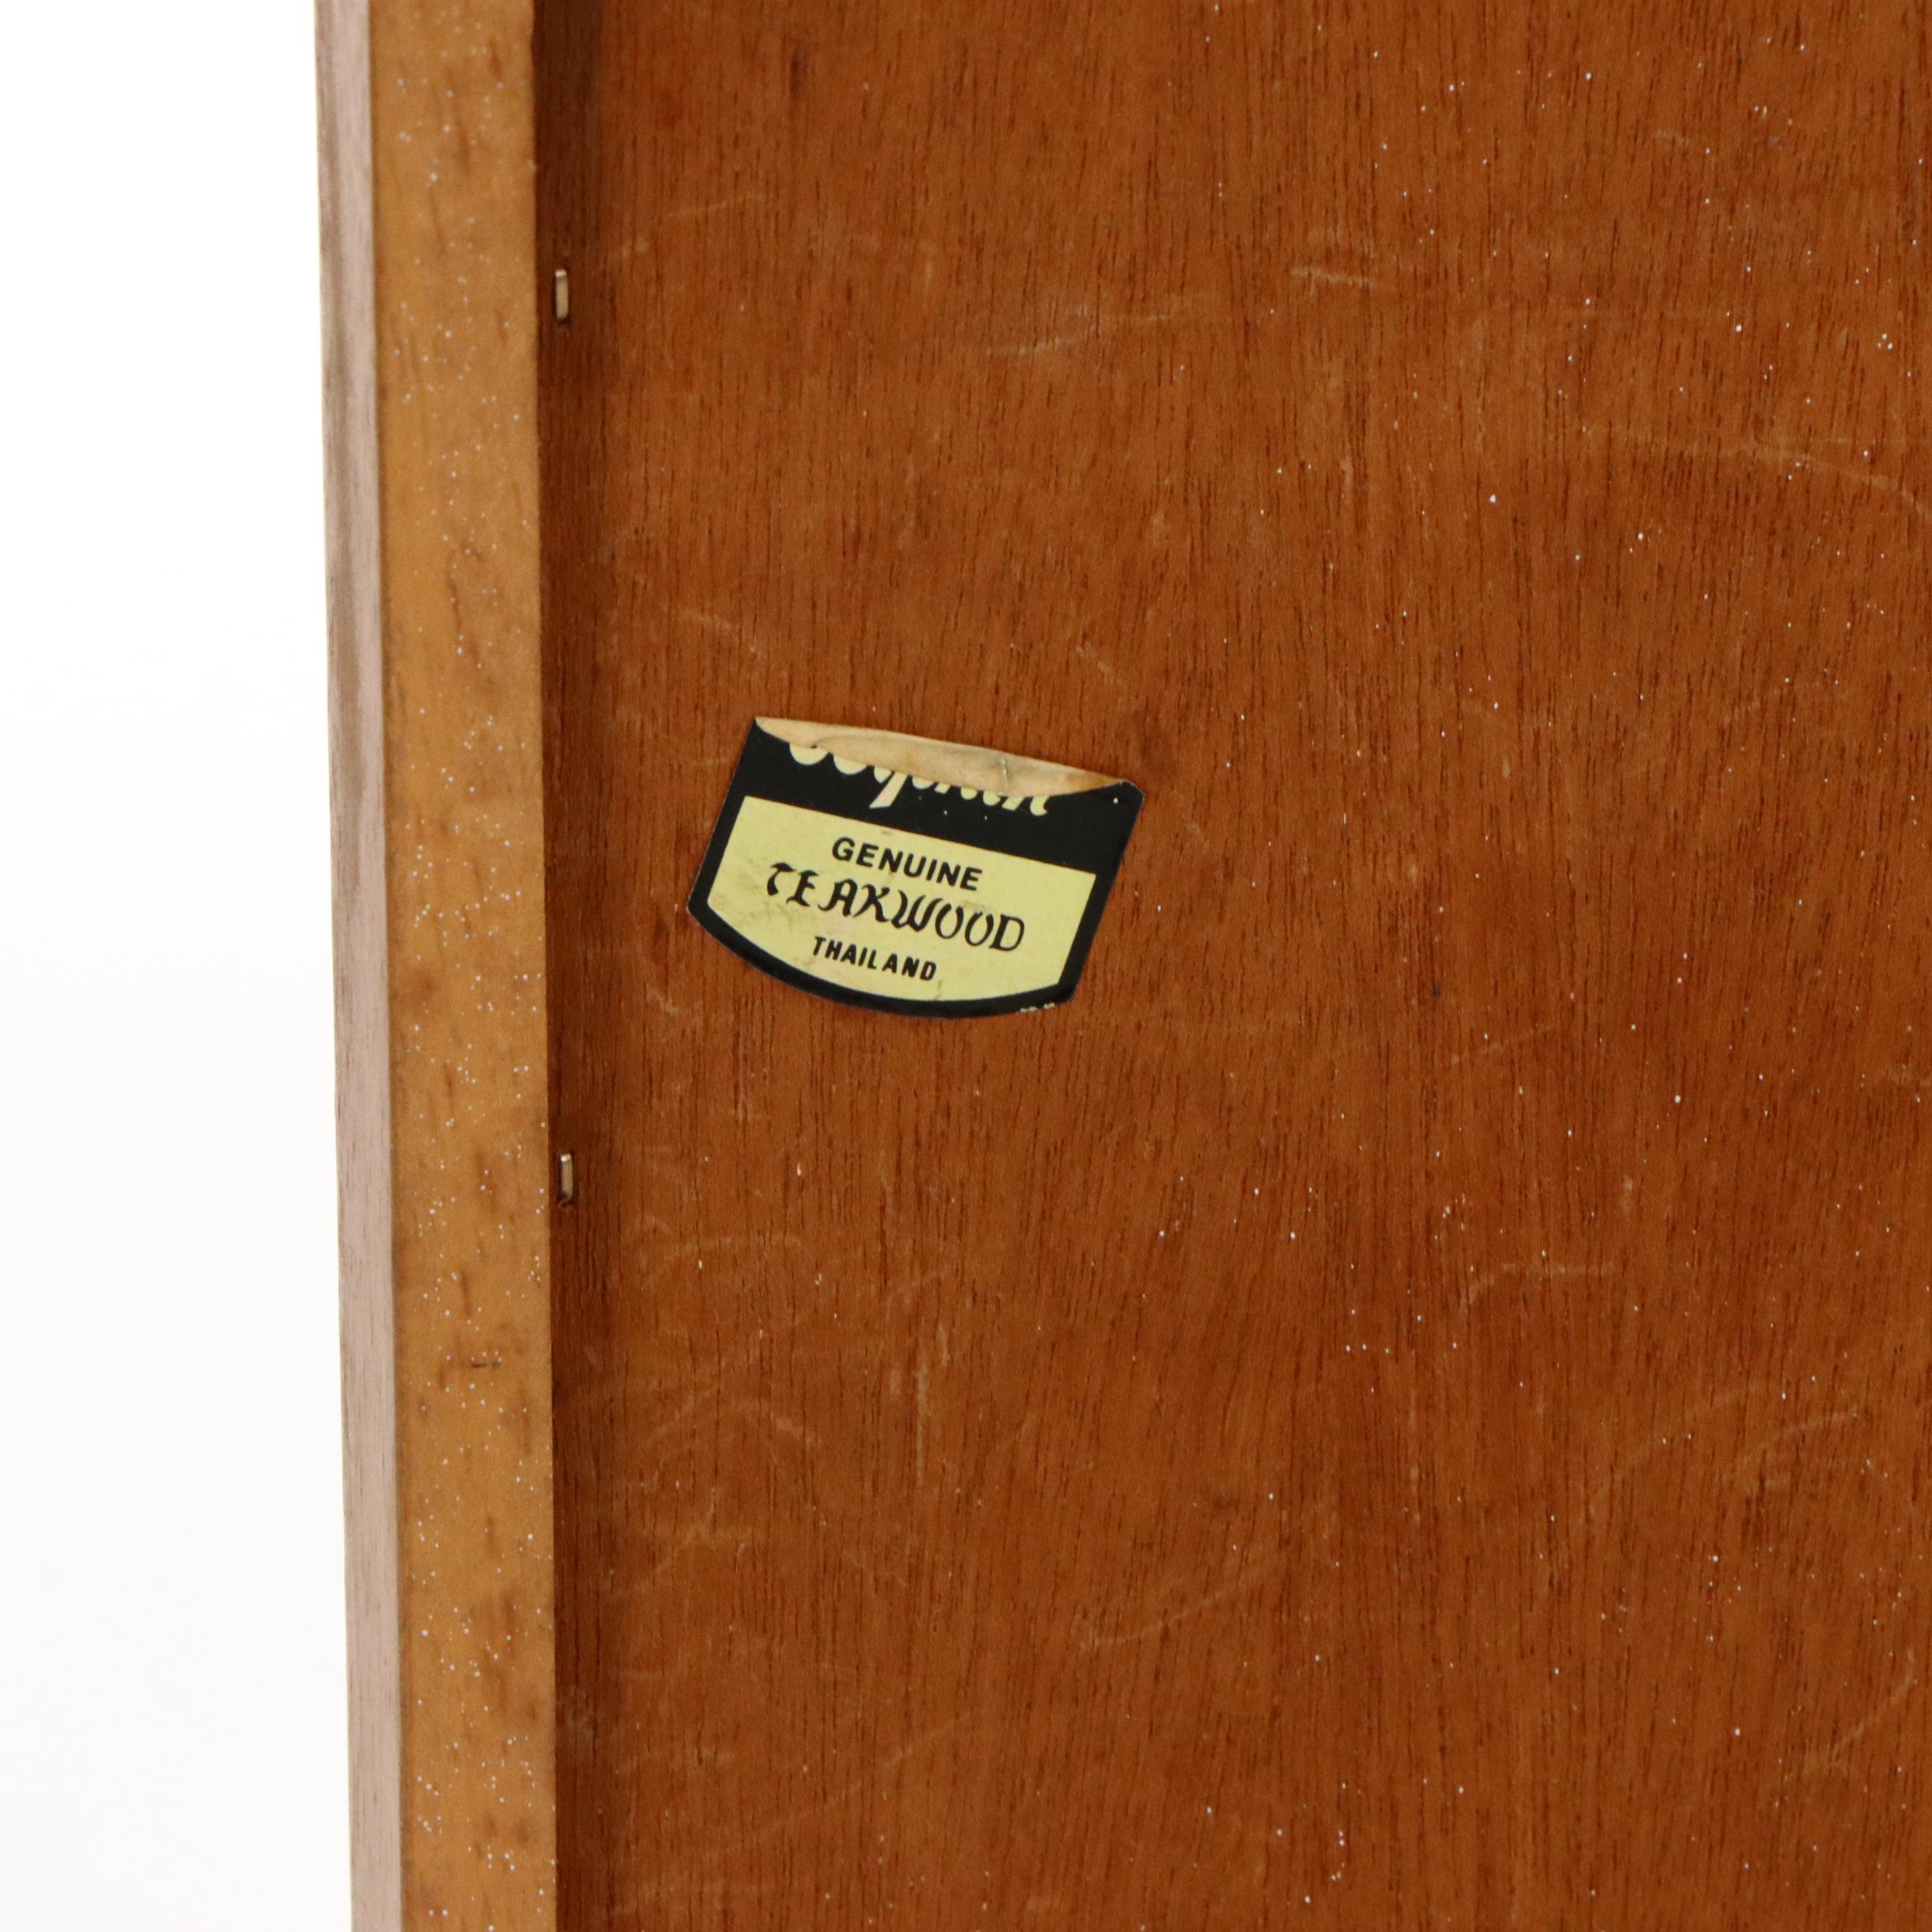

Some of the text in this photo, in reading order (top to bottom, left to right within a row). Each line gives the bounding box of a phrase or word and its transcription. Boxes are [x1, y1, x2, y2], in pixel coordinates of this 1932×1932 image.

[831, 837, 983, 891] GENUINE
[767, 862, 1026, 951] TEAKWOOD
[813, 935, 937, 981] THAILAND
